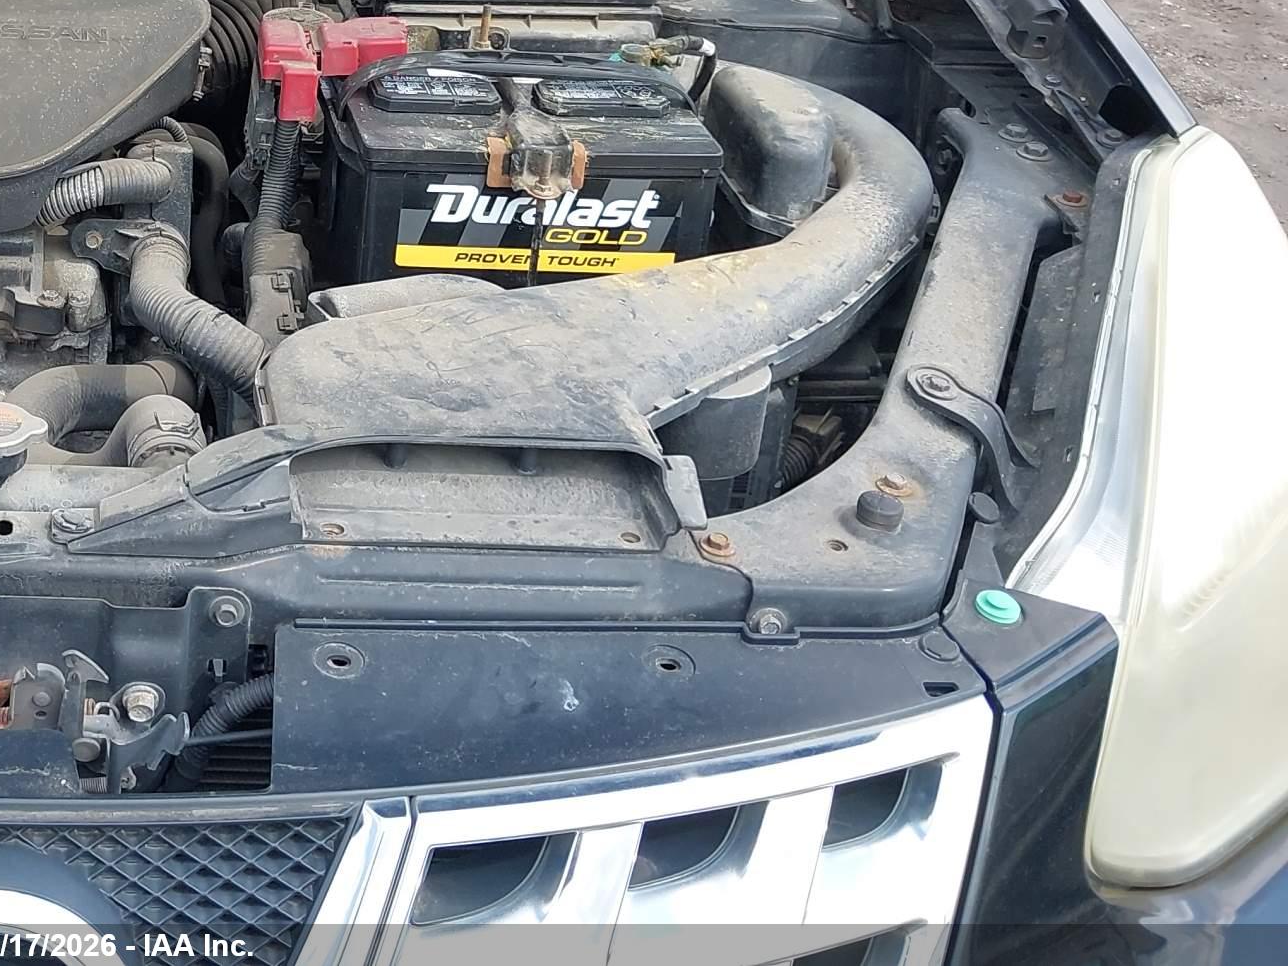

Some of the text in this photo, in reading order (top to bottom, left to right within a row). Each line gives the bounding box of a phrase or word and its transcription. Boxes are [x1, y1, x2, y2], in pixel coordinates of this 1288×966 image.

[426, 184, 658, 229] Duralast
[545, 228, 648, 246] GOLD
[547, 255, 616, 268] TOUGH
